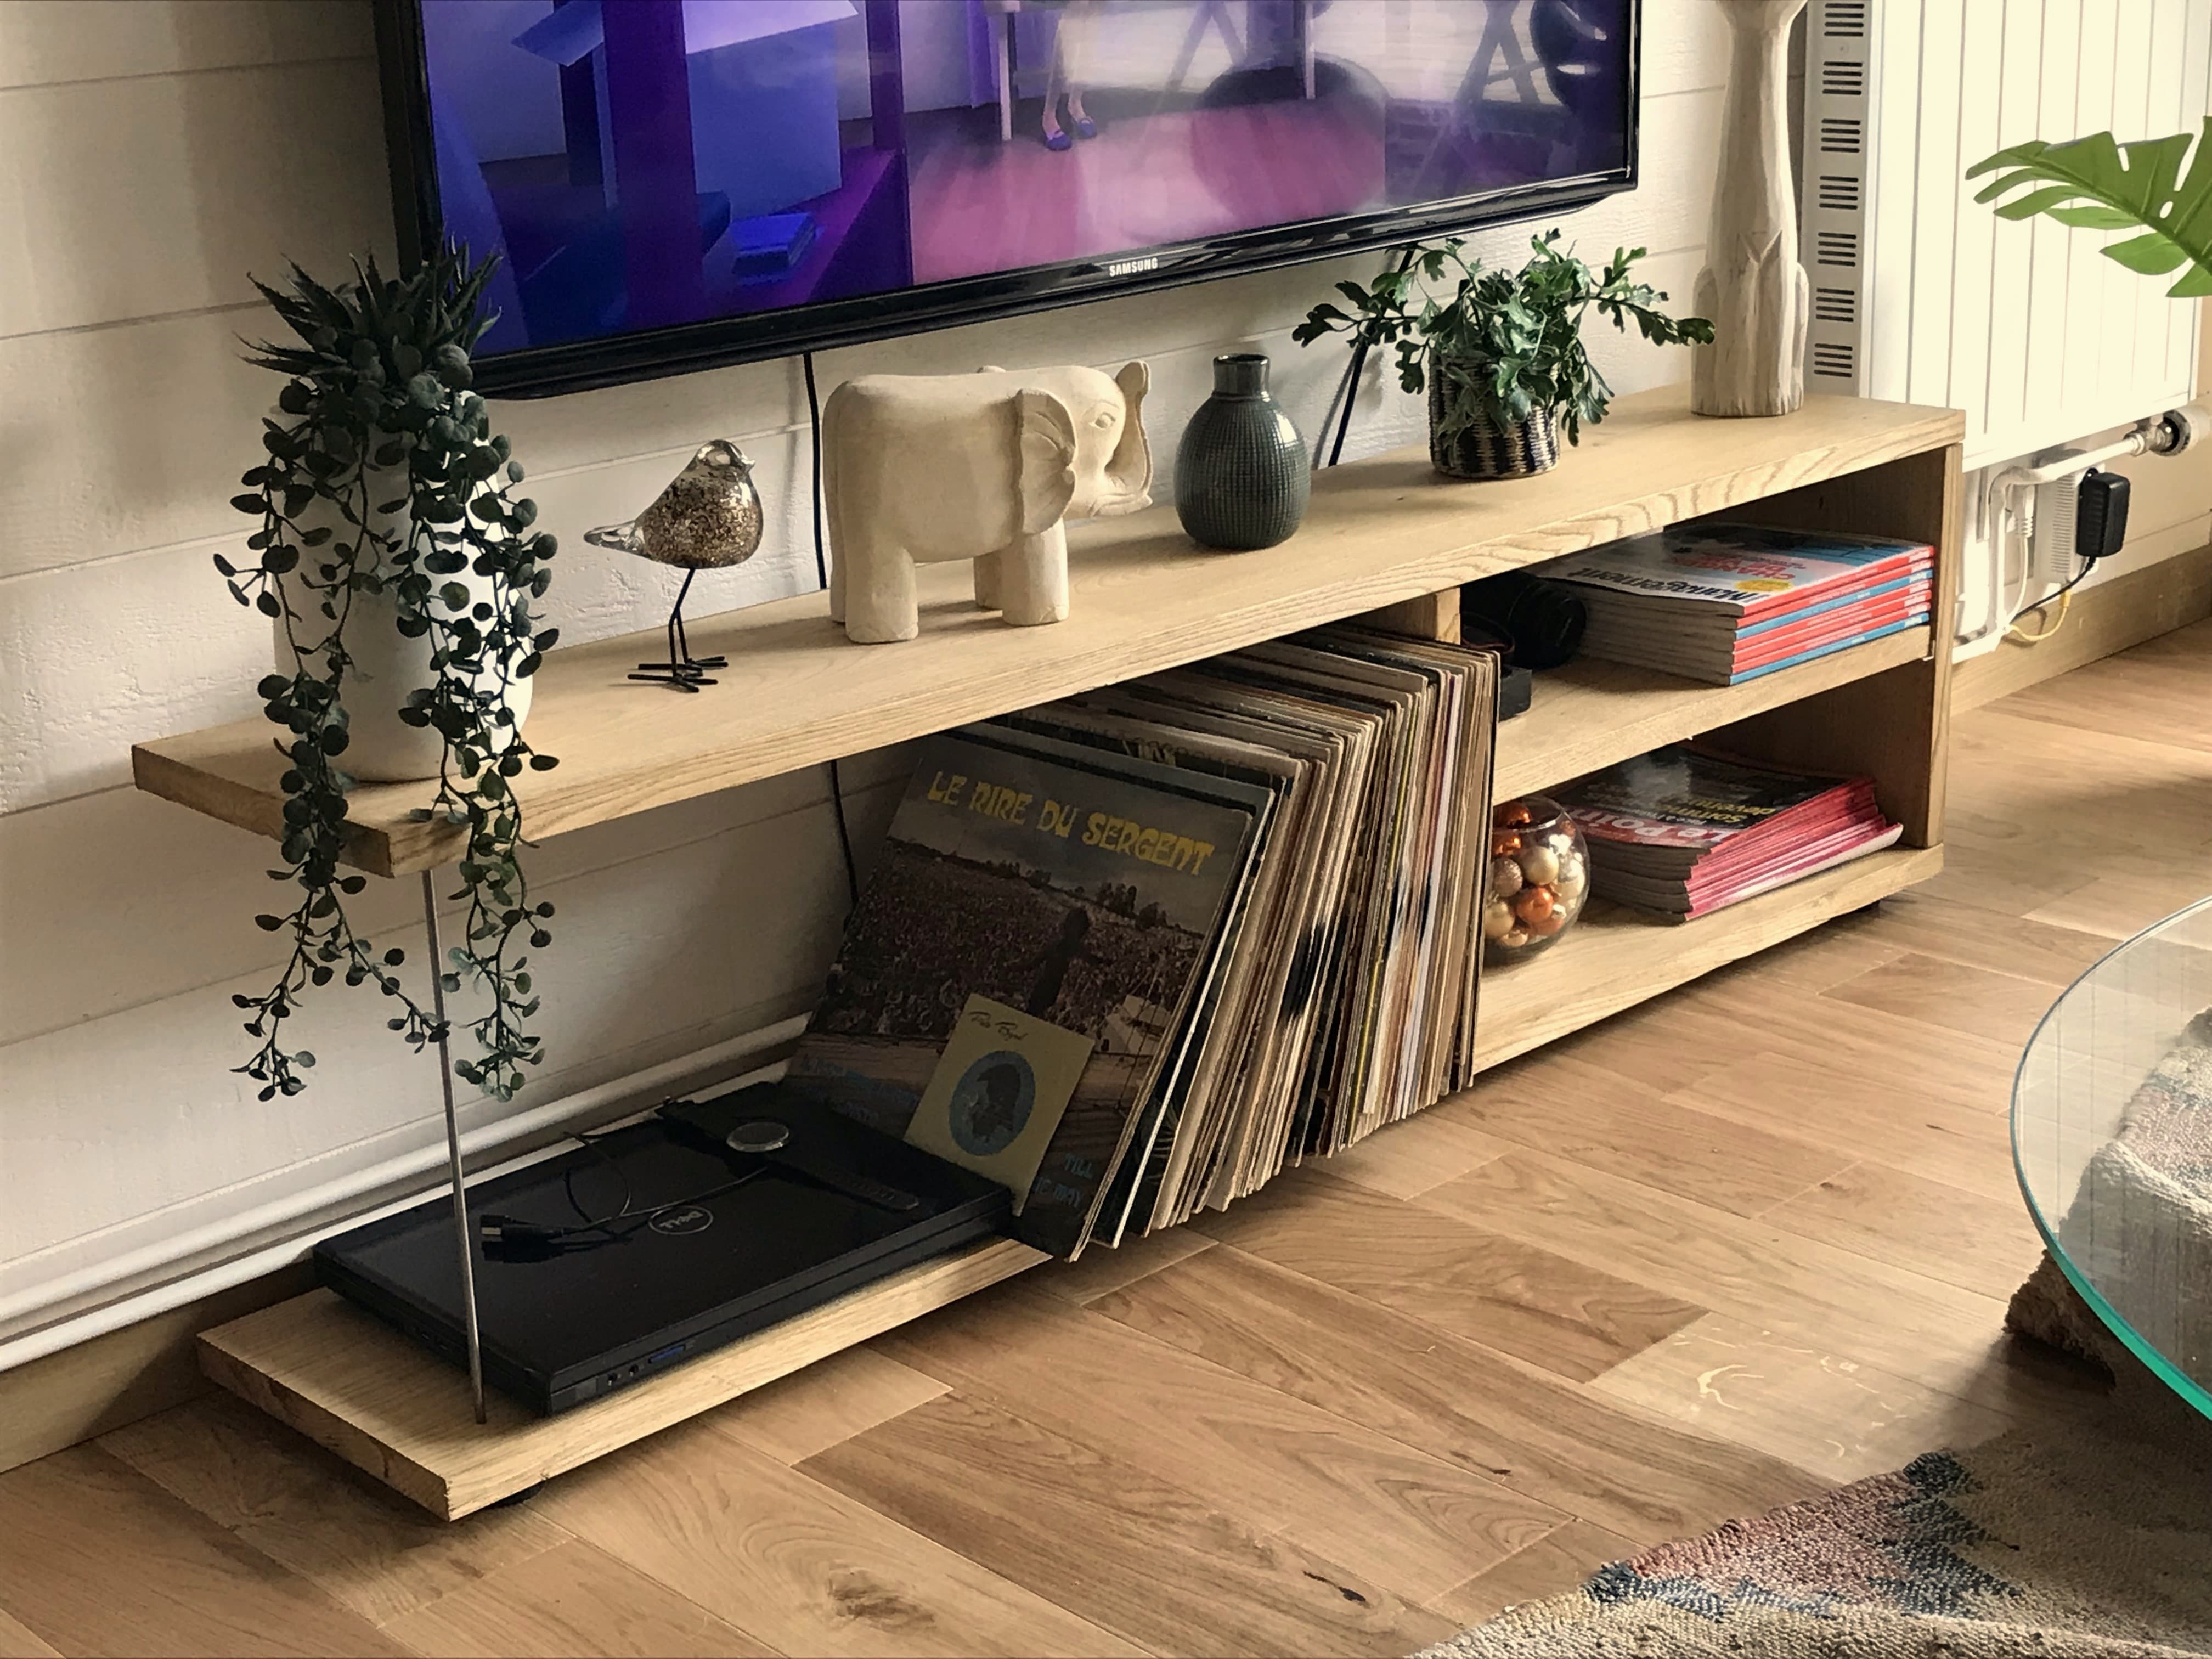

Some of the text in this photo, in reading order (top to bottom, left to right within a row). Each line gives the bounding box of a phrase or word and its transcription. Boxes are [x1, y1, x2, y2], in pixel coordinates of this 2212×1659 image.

[1109, 258, 1159, 277] SAMSUNG
[1567, 567, 1759, 602] Management
[927, 771, 1215, 875] LE RIRE DU SERGENT
[1567, 808, 1677, 838] Poin
[1677, 827, 1741, 842] Le
